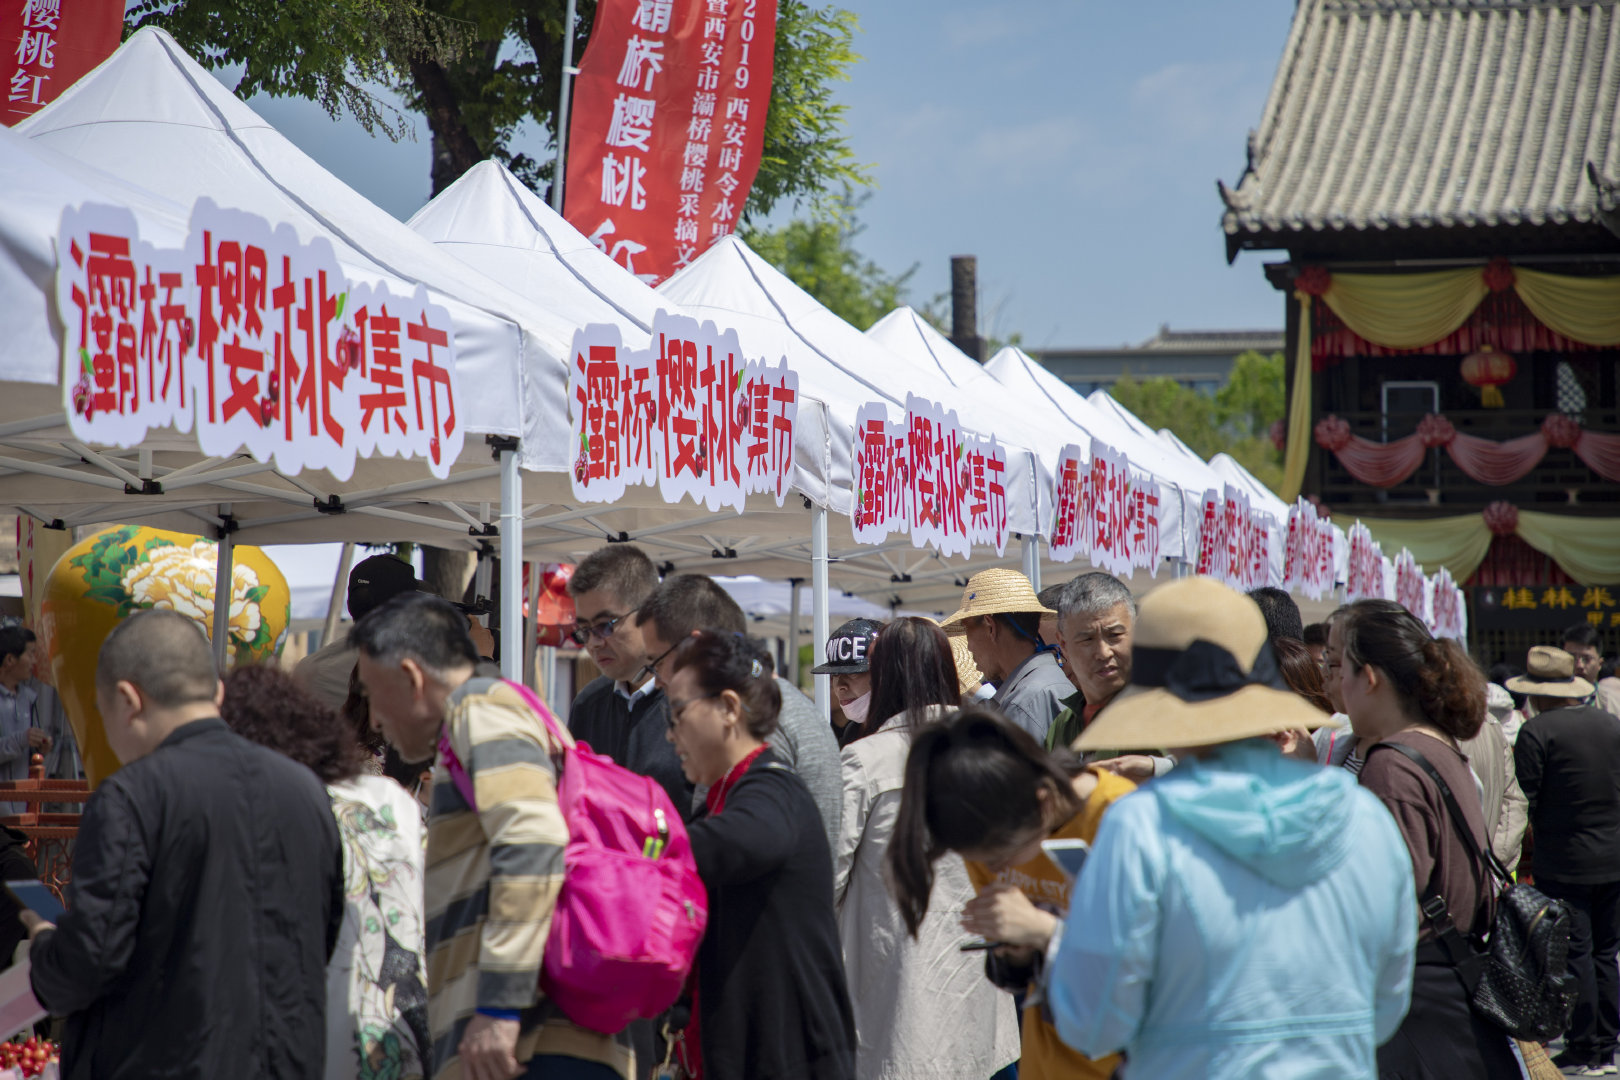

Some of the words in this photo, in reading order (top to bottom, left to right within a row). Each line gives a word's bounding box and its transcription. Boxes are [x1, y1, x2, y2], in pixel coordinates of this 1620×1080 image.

[8, 0, 60, 106] 樱桃红
[70, 230, 457, 460] 灞桥樱桃集市
[575, 333, 796, 494] 灞桥樱桃集市
[1501, 586, 1616, 609] 桂林米
